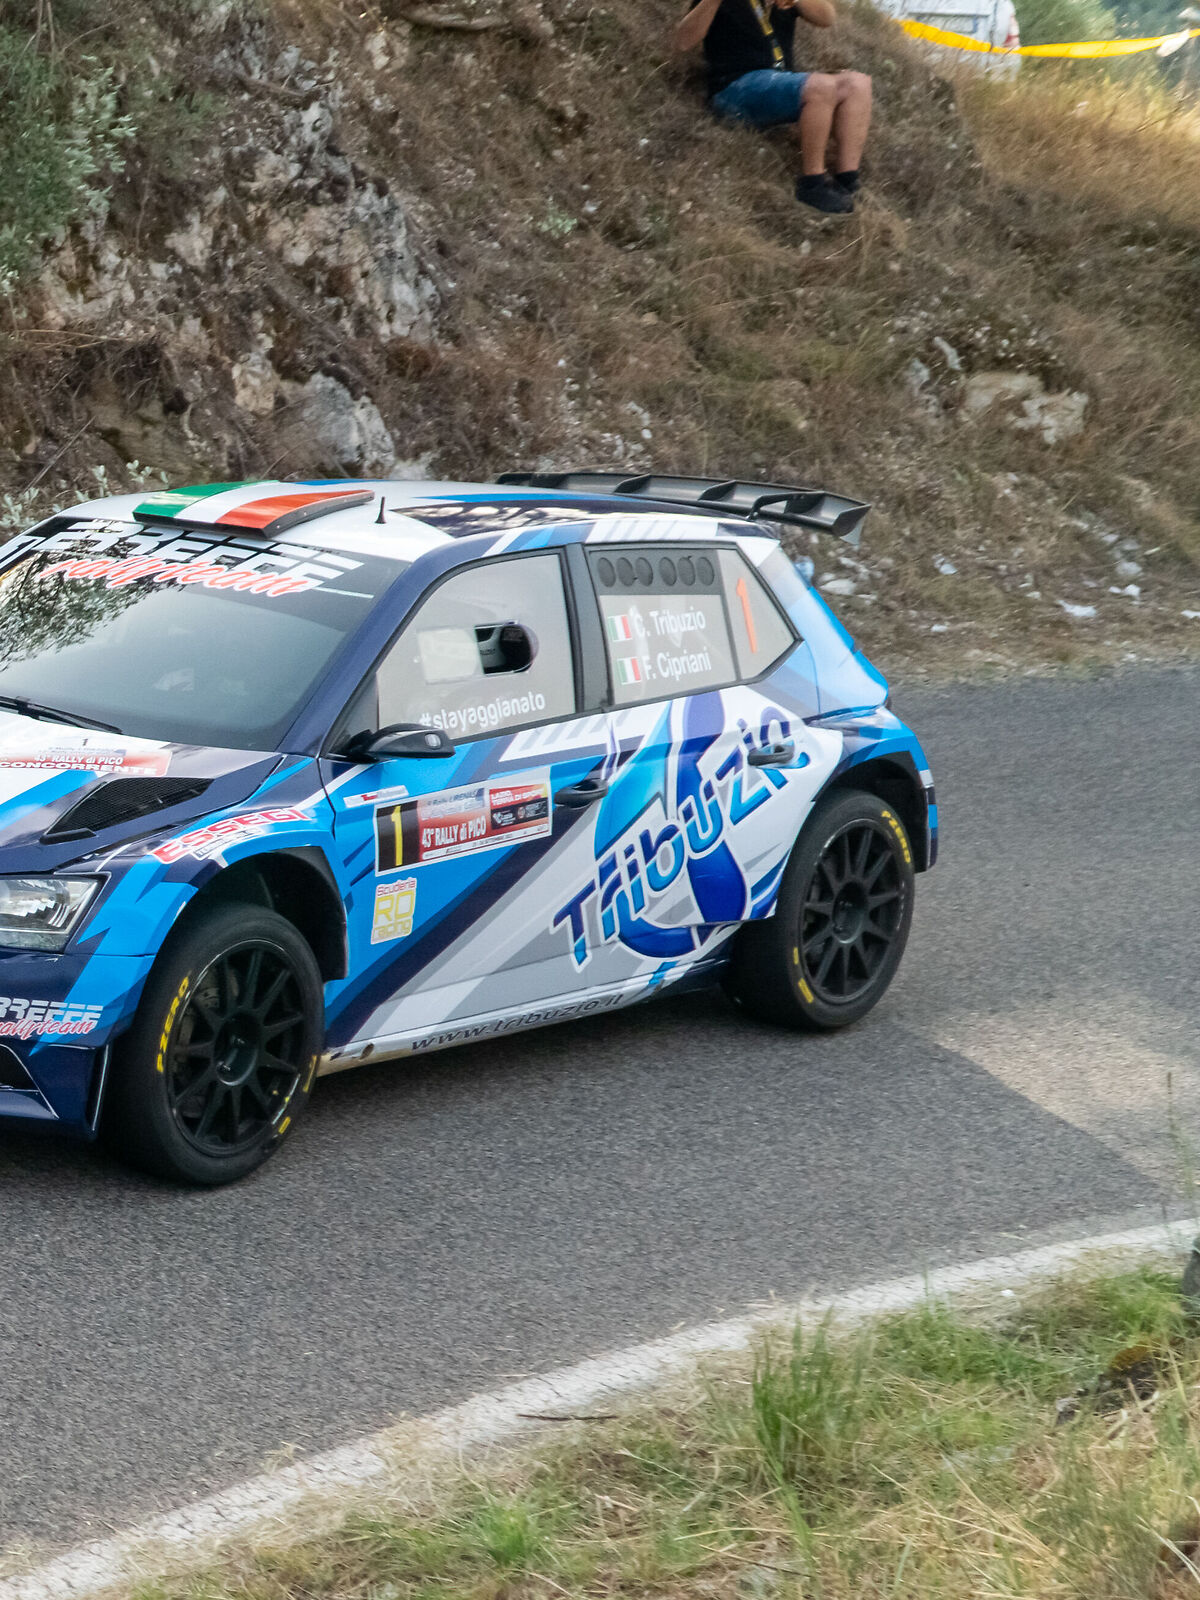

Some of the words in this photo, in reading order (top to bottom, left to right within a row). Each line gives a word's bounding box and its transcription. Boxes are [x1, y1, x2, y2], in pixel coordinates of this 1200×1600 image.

[649, 606, 706, 636] Tribuzio
[736, 577, 758, 654] 1
[641, 656, 657, 681] F.
[657, 646, 712, 682] Cipriani
[418, 691, 546, 732] #stayaggianato
[52, 755, 84, 764] RALLY
[85, 757, 96, 765] di
[97, 757, 124, 766] PICO
[82, 738, 89, 747] 1
[152, 808, 312, 863] ESSEGI
[391, 804, 403, 867] 1
[421, 827, 436, 848] 43°
[434, 823, 460, 847] RALLY
[459, 820, 468, 841] di
[467, 815, 487, 838] PICO
[551, 704, 812, 971] Tribuzio
[410, 993, 624, 1051] www.tribuzio.it
